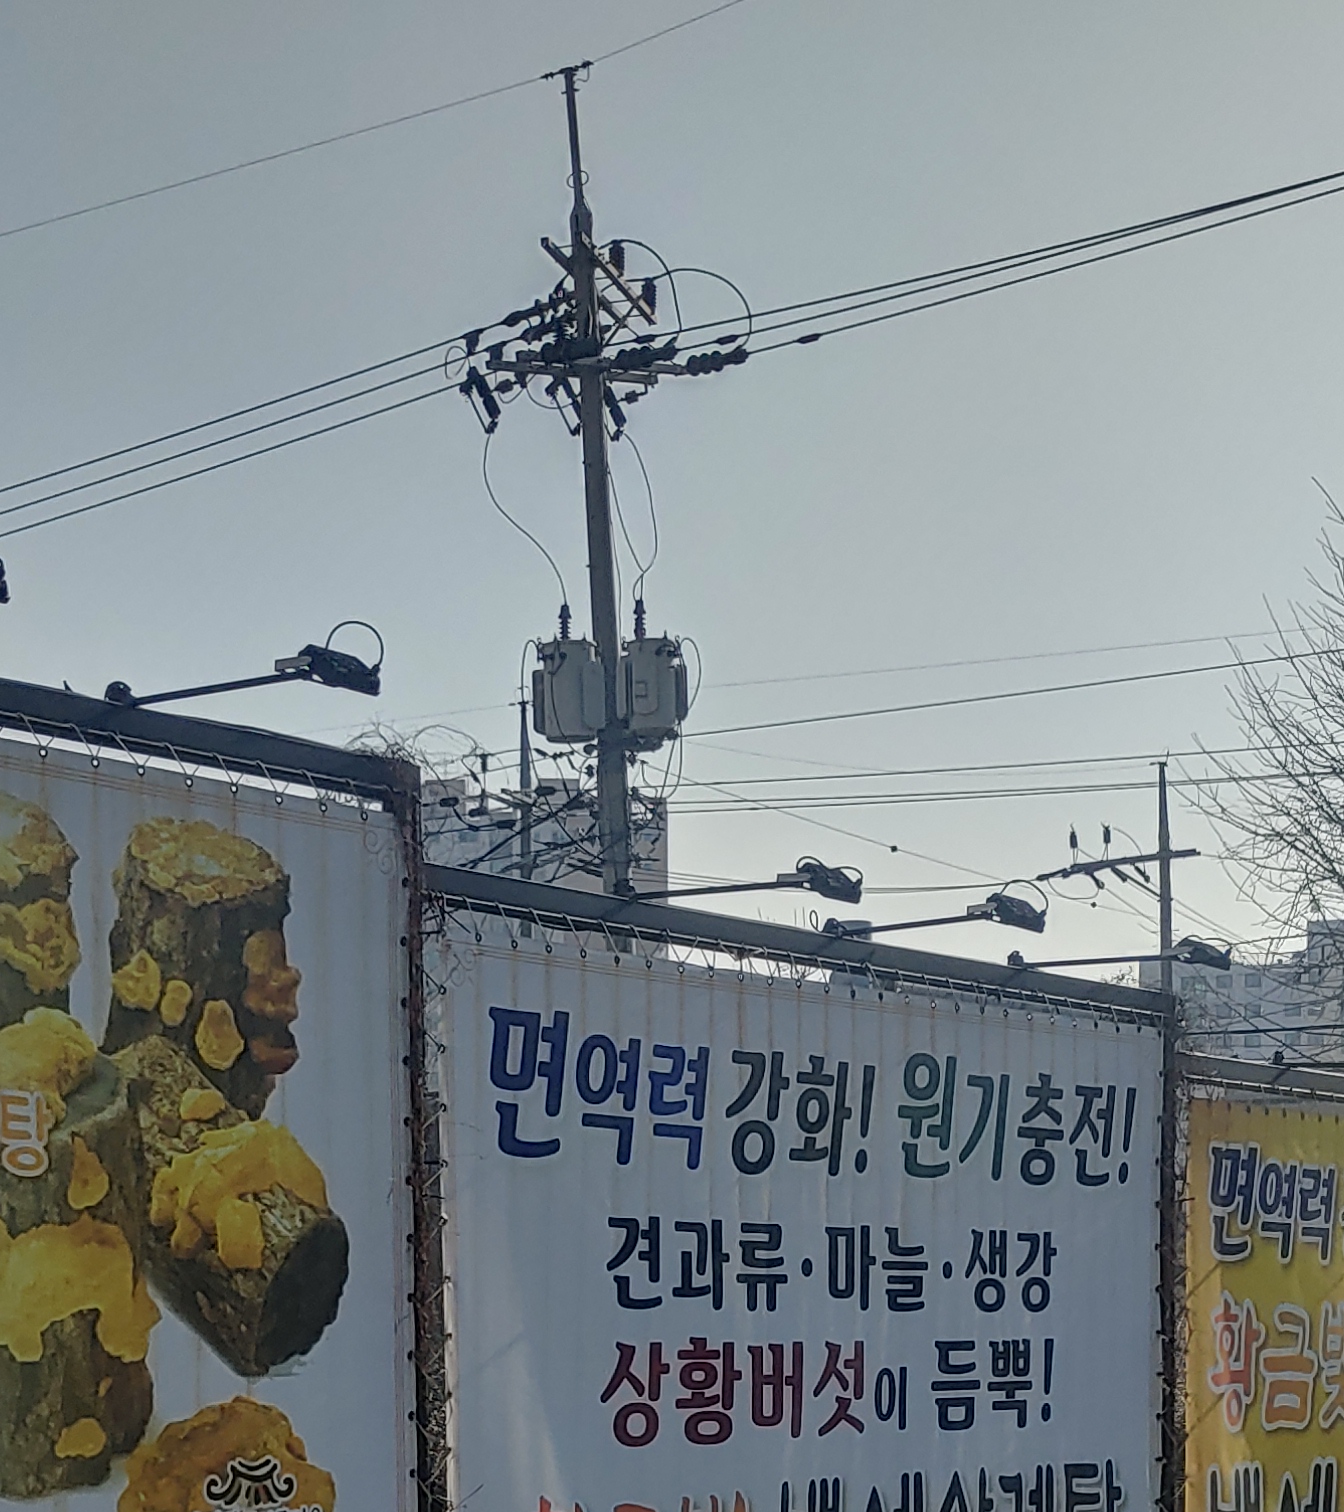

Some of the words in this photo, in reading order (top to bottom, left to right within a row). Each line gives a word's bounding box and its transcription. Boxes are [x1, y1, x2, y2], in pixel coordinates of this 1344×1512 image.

[489, 1006, 709, 1170] 면역력
[725, 1050, 875, 1177] 강화!
[897, 1052, 1137, 1187] 원기충전!
[1212, 1147, 1334, 1258] 면역력
[600, 1336, 907, 1448] 상황버섯이
[930, 1338, 1054, 1431] 듬뿍!
